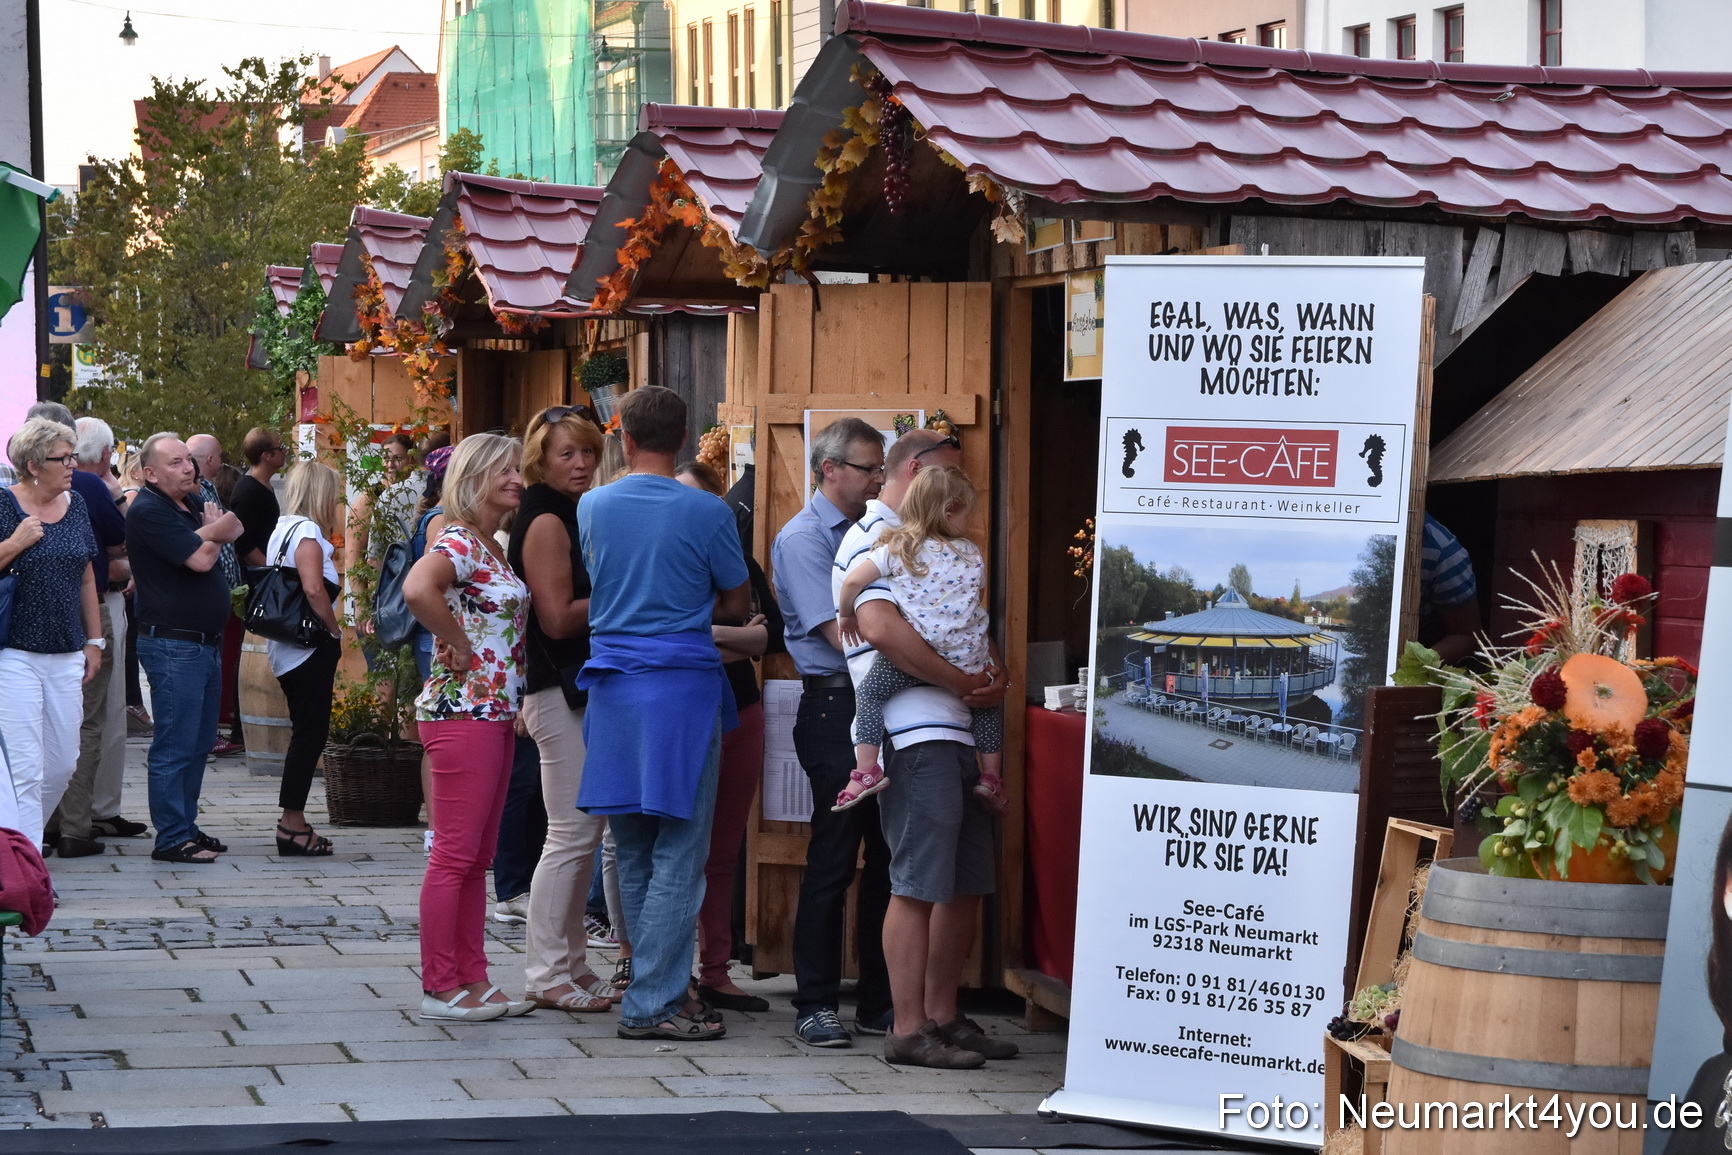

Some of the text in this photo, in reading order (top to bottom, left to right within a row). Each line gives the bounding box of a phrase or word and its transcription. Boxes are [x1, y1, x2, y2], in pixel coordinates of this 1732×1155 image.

[1150, 301, 1375, 333] EGAL, WAS, WANN
[1149, 334, 1372, 364] UND WO SIE FEIERN
[1200, 361, 1320, 397] MÖCHTEN:
[1277, 499, 1361, 514] Weinkeller
[1133, 804, 1319, 845] WIR SIND GERNE
[1165, 833, 1288, 876] FÜR SIE DA!
[1183, 900, 1264, 922] See-Café
[1129, 913, 1318, 945] im LGS-Park Neumarkt
[1153, 934, 1292, 961] 92318 Neumarkt
[1116, 966, 1325, 1002] Telefon: 0 91 81/460130
[1127, 985, 1311, 1017] Fax: 0 91 81/26 35 87
[1178, 1026, 1251, 1047] Internet:
[1105, 1037, 1325, 1075] www.seecafe-neumarkt.de
